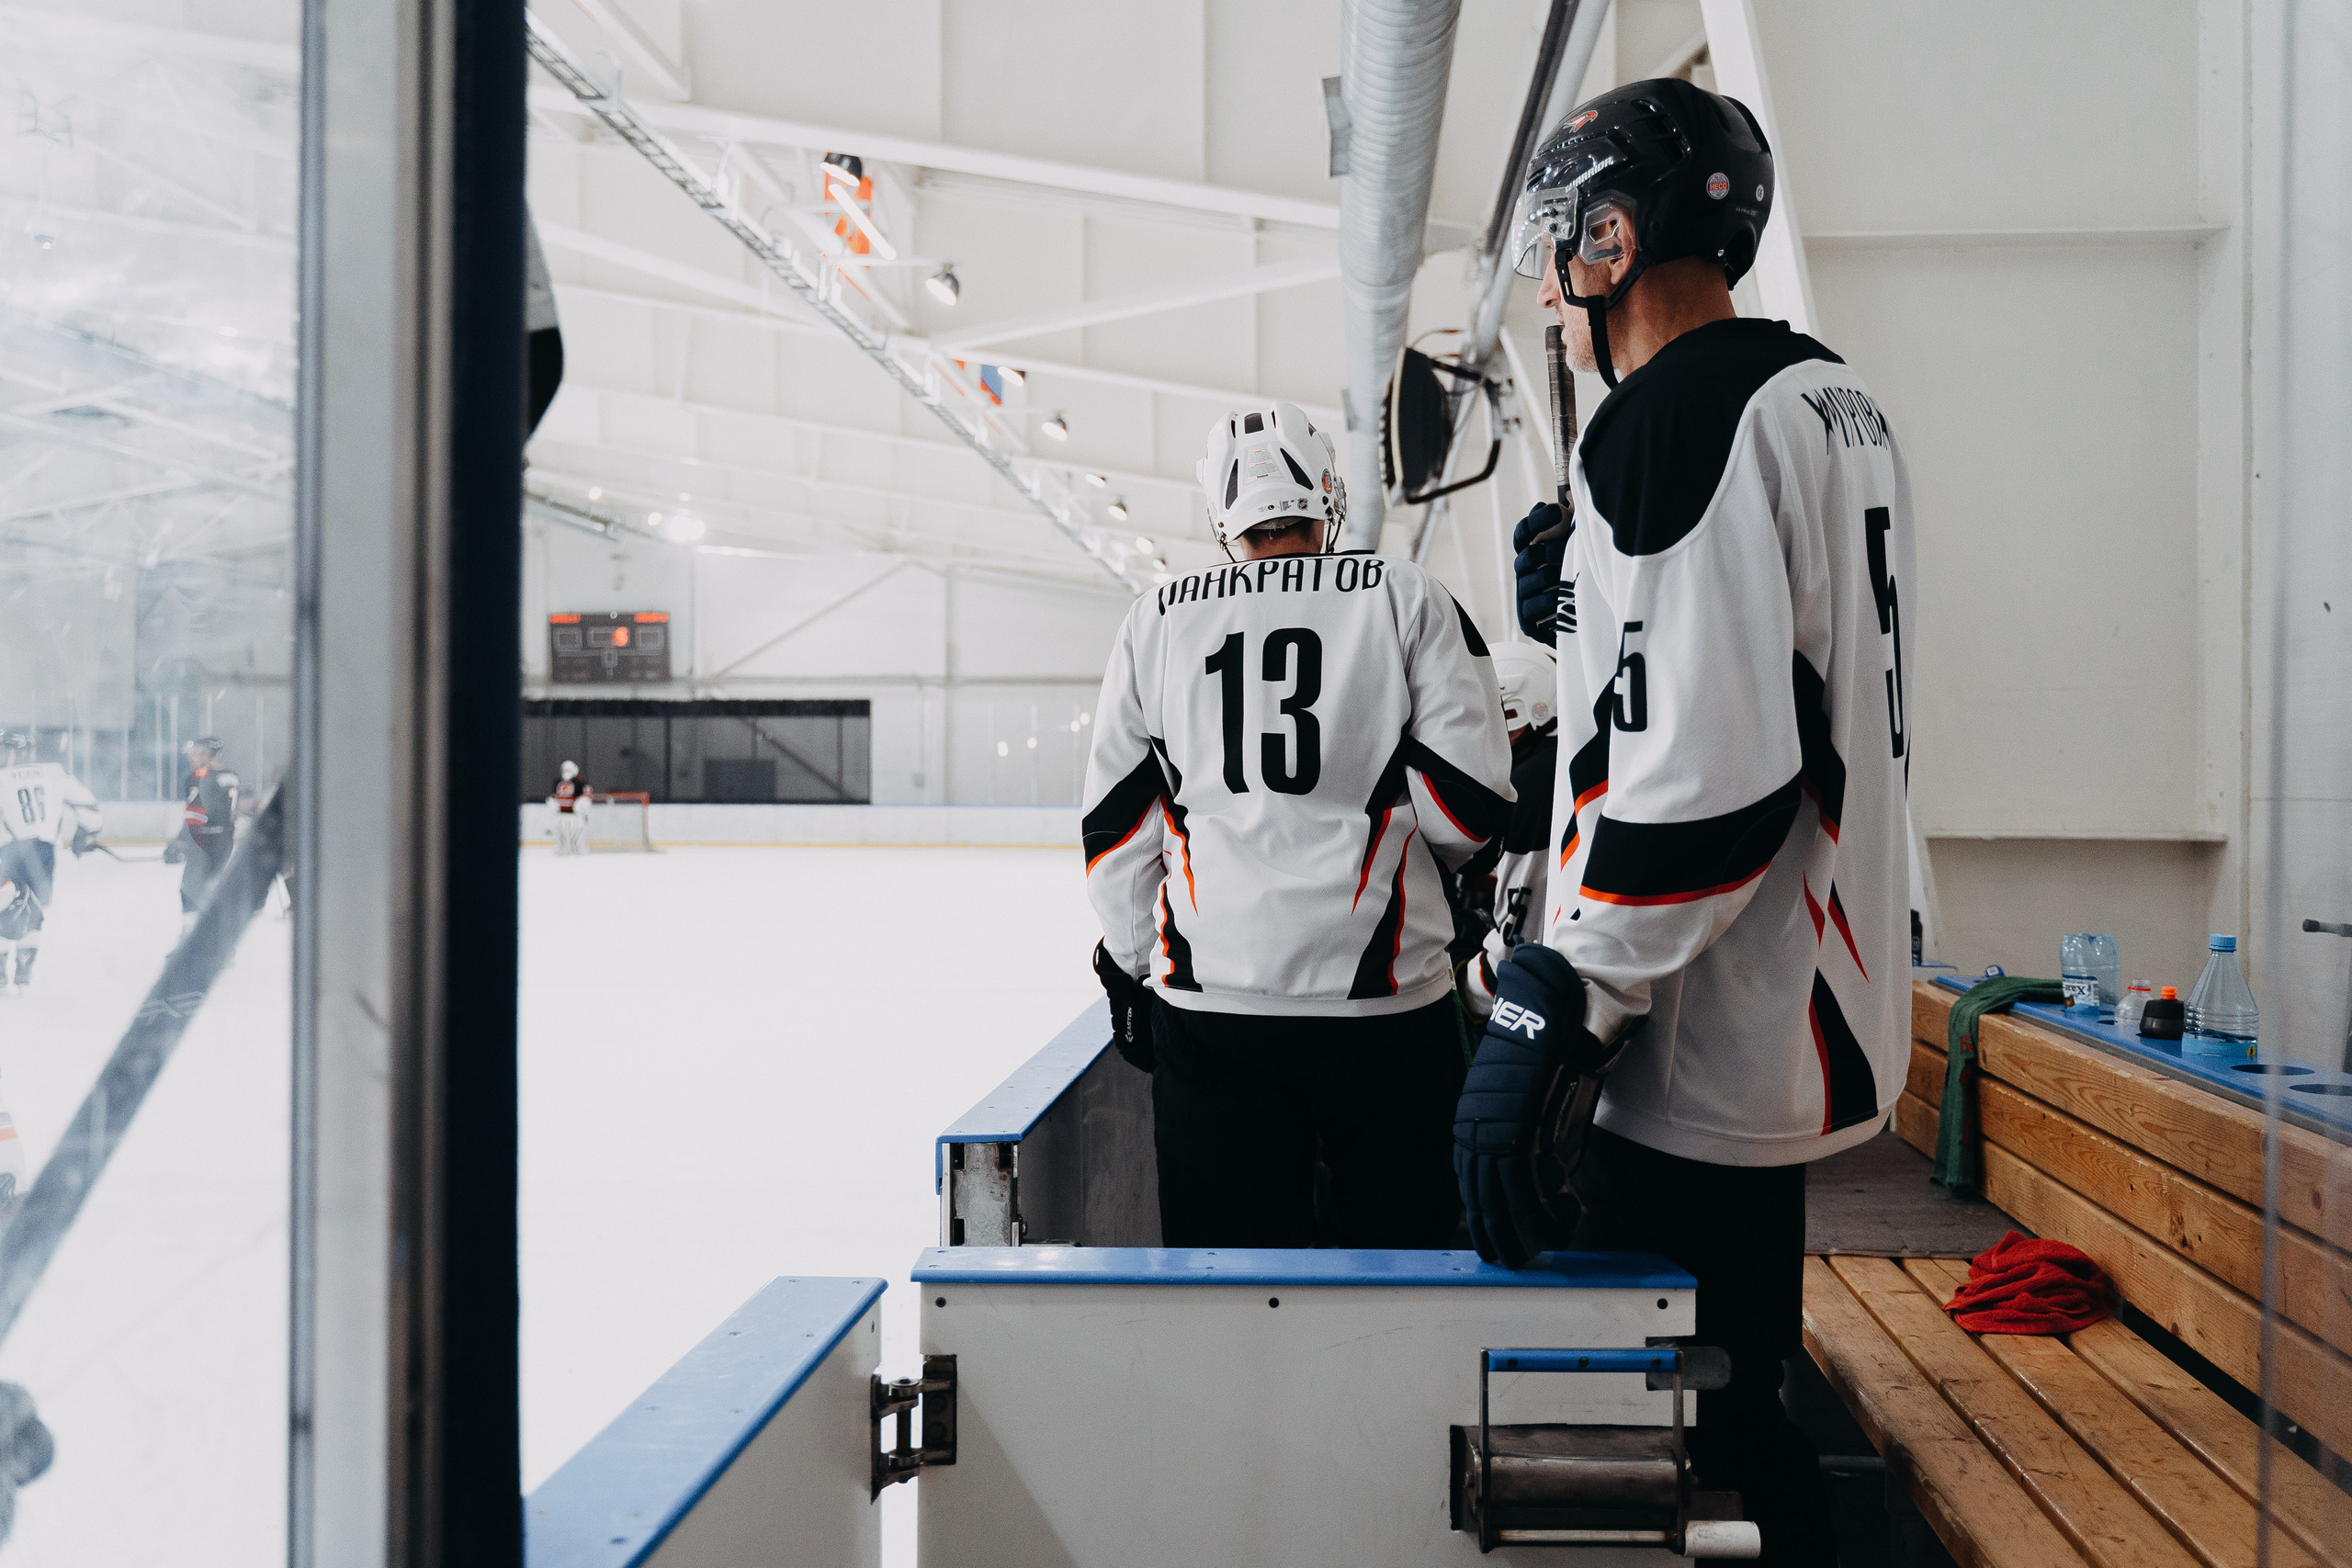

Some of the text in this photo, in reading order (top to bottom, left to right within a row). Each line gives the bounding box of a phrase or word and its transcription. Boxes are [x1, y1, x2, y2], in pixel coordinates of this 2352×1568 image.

[1158, 557, 1385, 616] ПАНКРАТОВ
[1864, 506, 1905, 759] 5
[1205, 627, 1323, 795] 13
[1612, 621, 1647, 732] 5
